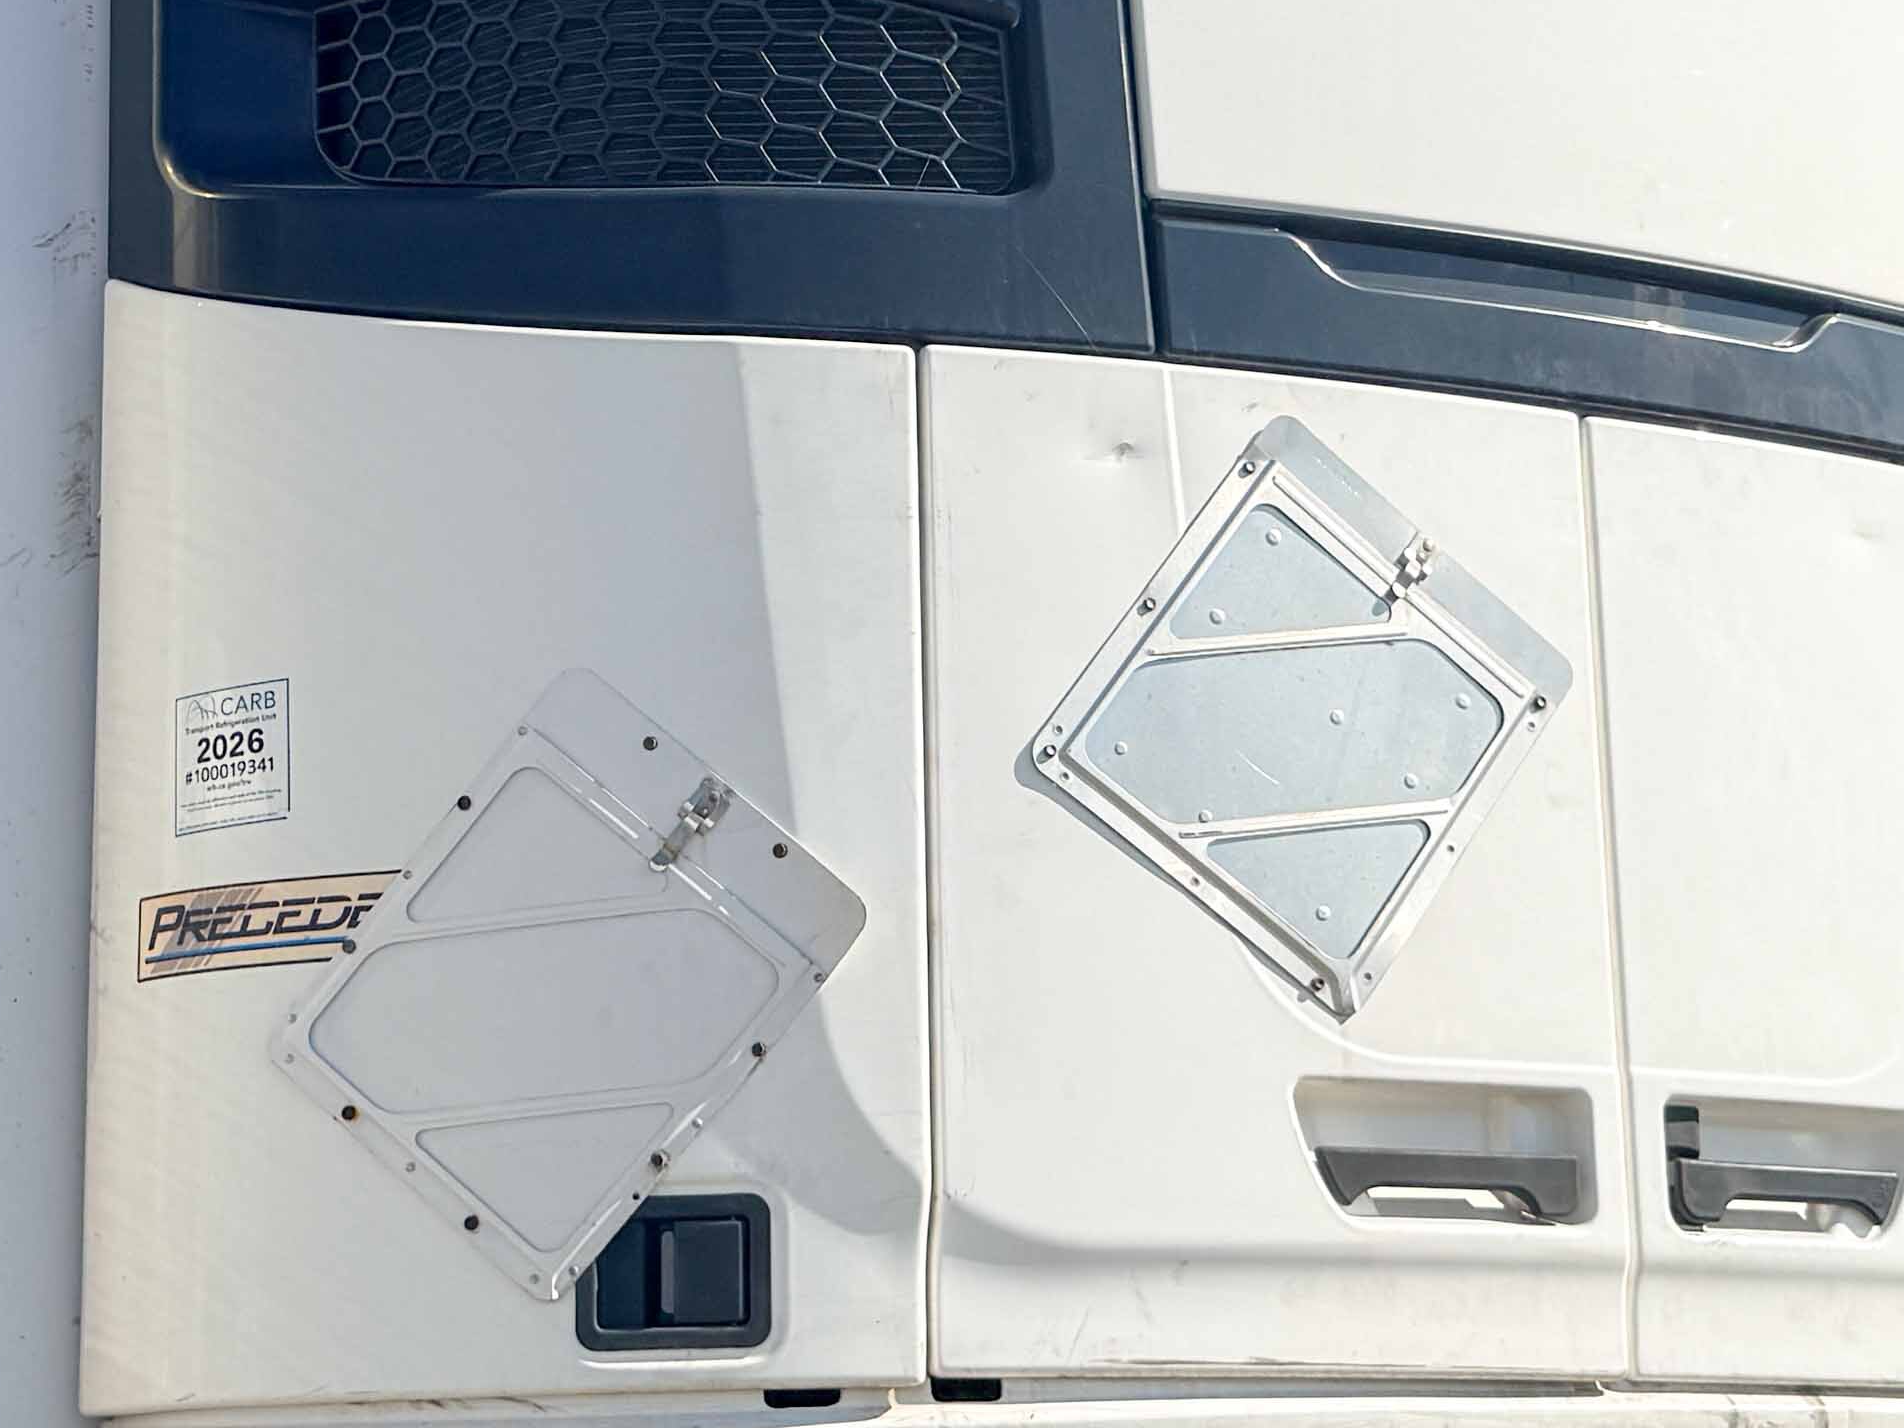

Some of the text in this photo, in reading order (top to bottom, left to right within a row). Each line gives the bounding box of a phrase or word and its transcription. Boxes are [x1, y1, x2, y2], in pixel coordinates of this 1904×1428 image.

[220, 690, 277, 716] CARB
[197, 728, 265, 764] 2026
[185, 756, 275, 785] #100019341
[148, 892, 384, 951] PRECEDE
